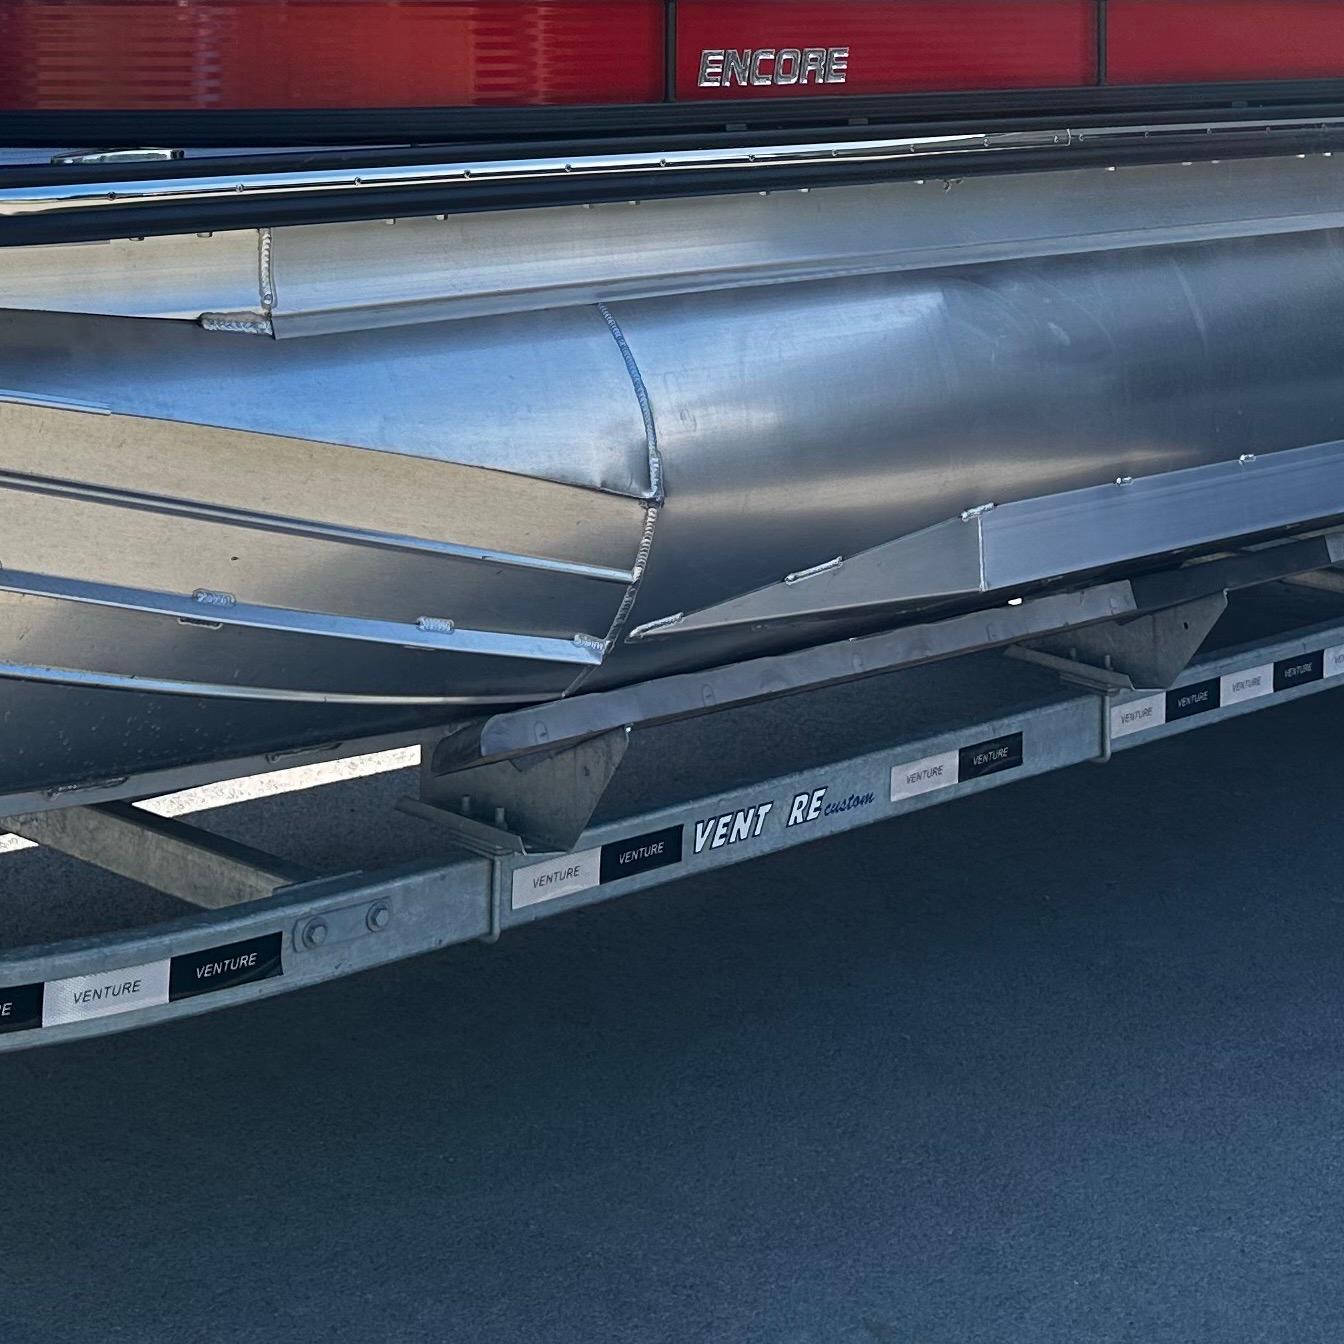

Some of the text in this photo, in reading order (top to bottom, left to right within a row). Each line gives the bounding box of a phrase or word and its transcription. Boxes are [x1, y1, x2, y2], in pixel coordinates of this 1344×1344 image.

[697, 46, 850, 88] ENCORE
[1284, 661, 1313, 678] VENTURE
[1232, 675, 1262, 693] VENTURE
[1177, 690, 1209, 708] VENTURE
[1120, 706, 1154, 725] VENTURE
[973, 746, 1009, 766] VENTURE
[906, 764, 944, 785] VENTURE
[824, 792, 875, 817] custom
[619, 840, 665, 865] VENTURE
[532, 865, 581, 889] VENTURE
[195, 952, 258, 980] VENTURE
[73, 979, 142, 1005] VENTURE
